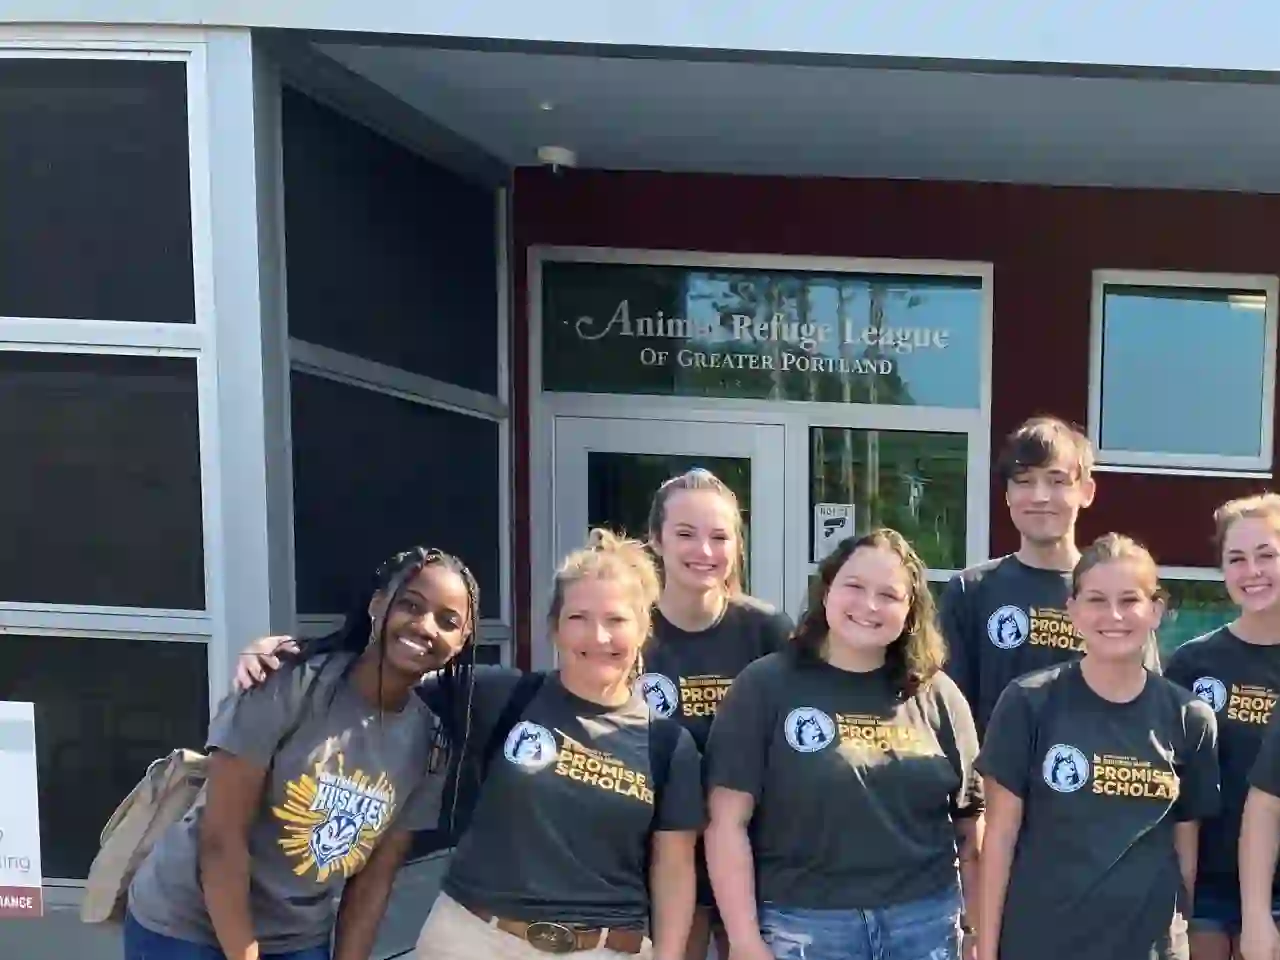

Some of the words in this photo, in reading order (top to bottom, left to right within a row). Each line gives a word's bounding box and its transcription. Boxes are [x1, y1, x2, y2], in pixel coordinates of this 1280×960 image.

[576, 299, 723, 341] Animal
[732, 313, 831, 353] Refuge
[844, 316, 951, 354] League
[640, 348, 669, 367] OF
[678, 349, 774, 371] GREATER
[780, 351, 893, 376] PORTLAND
[680, 686, 729, 702] PROM
[554, 762, 656, 805] SCHOLAR
[558, 750, 646, 788] PROMISE
[1091, 780, 1179, 800] SCHOLAR
